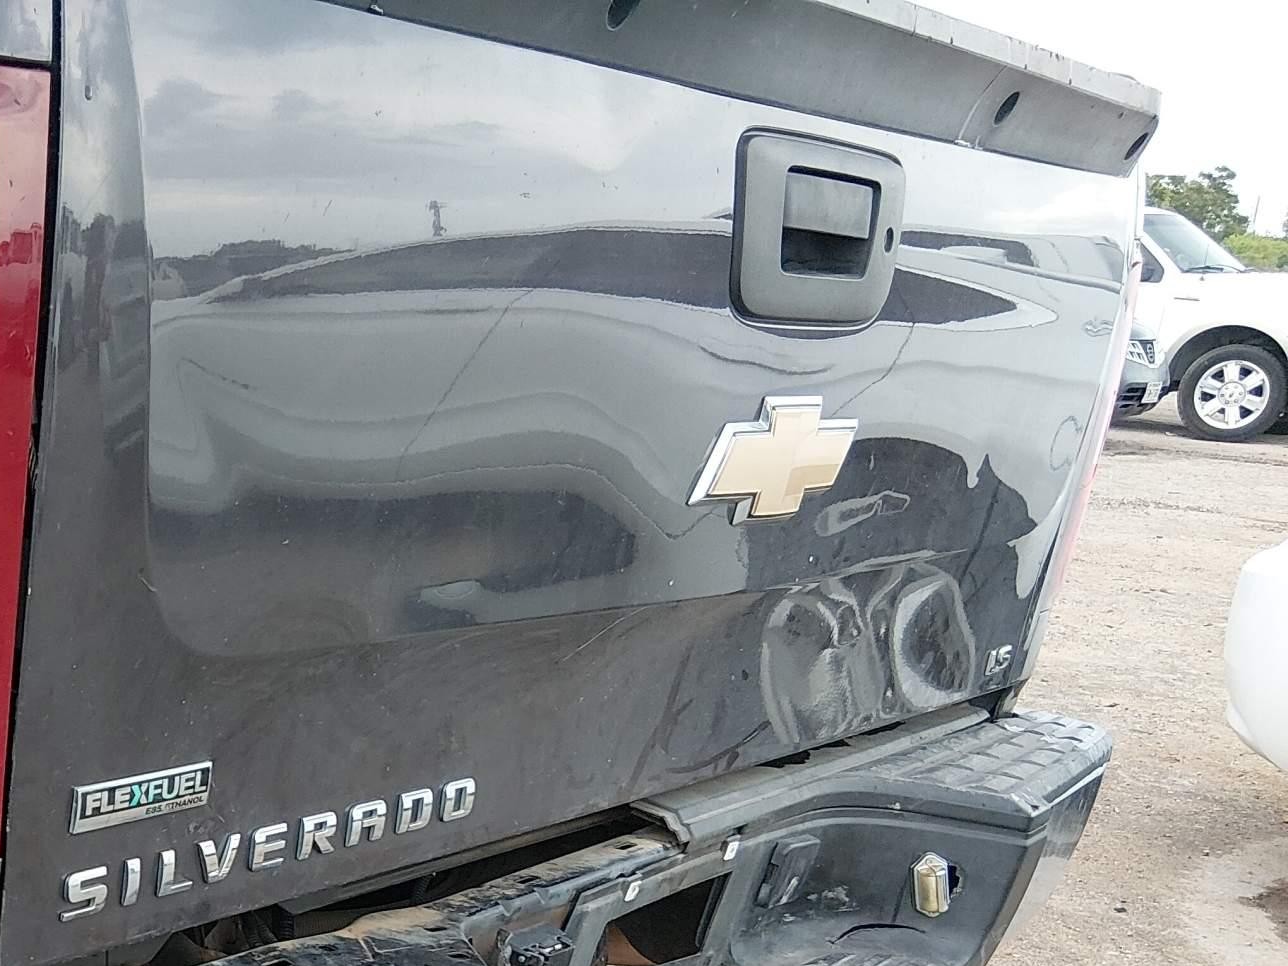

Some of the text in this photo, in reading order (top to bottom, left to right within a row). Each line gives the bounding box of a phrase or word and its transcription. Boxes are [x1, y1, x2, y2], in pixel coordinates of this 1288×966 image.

[984, 644, 1013, 676] LS
[84, 769, 207, 817] FLEXFUEL
[59, 777, 476, 922] SILVERADO
